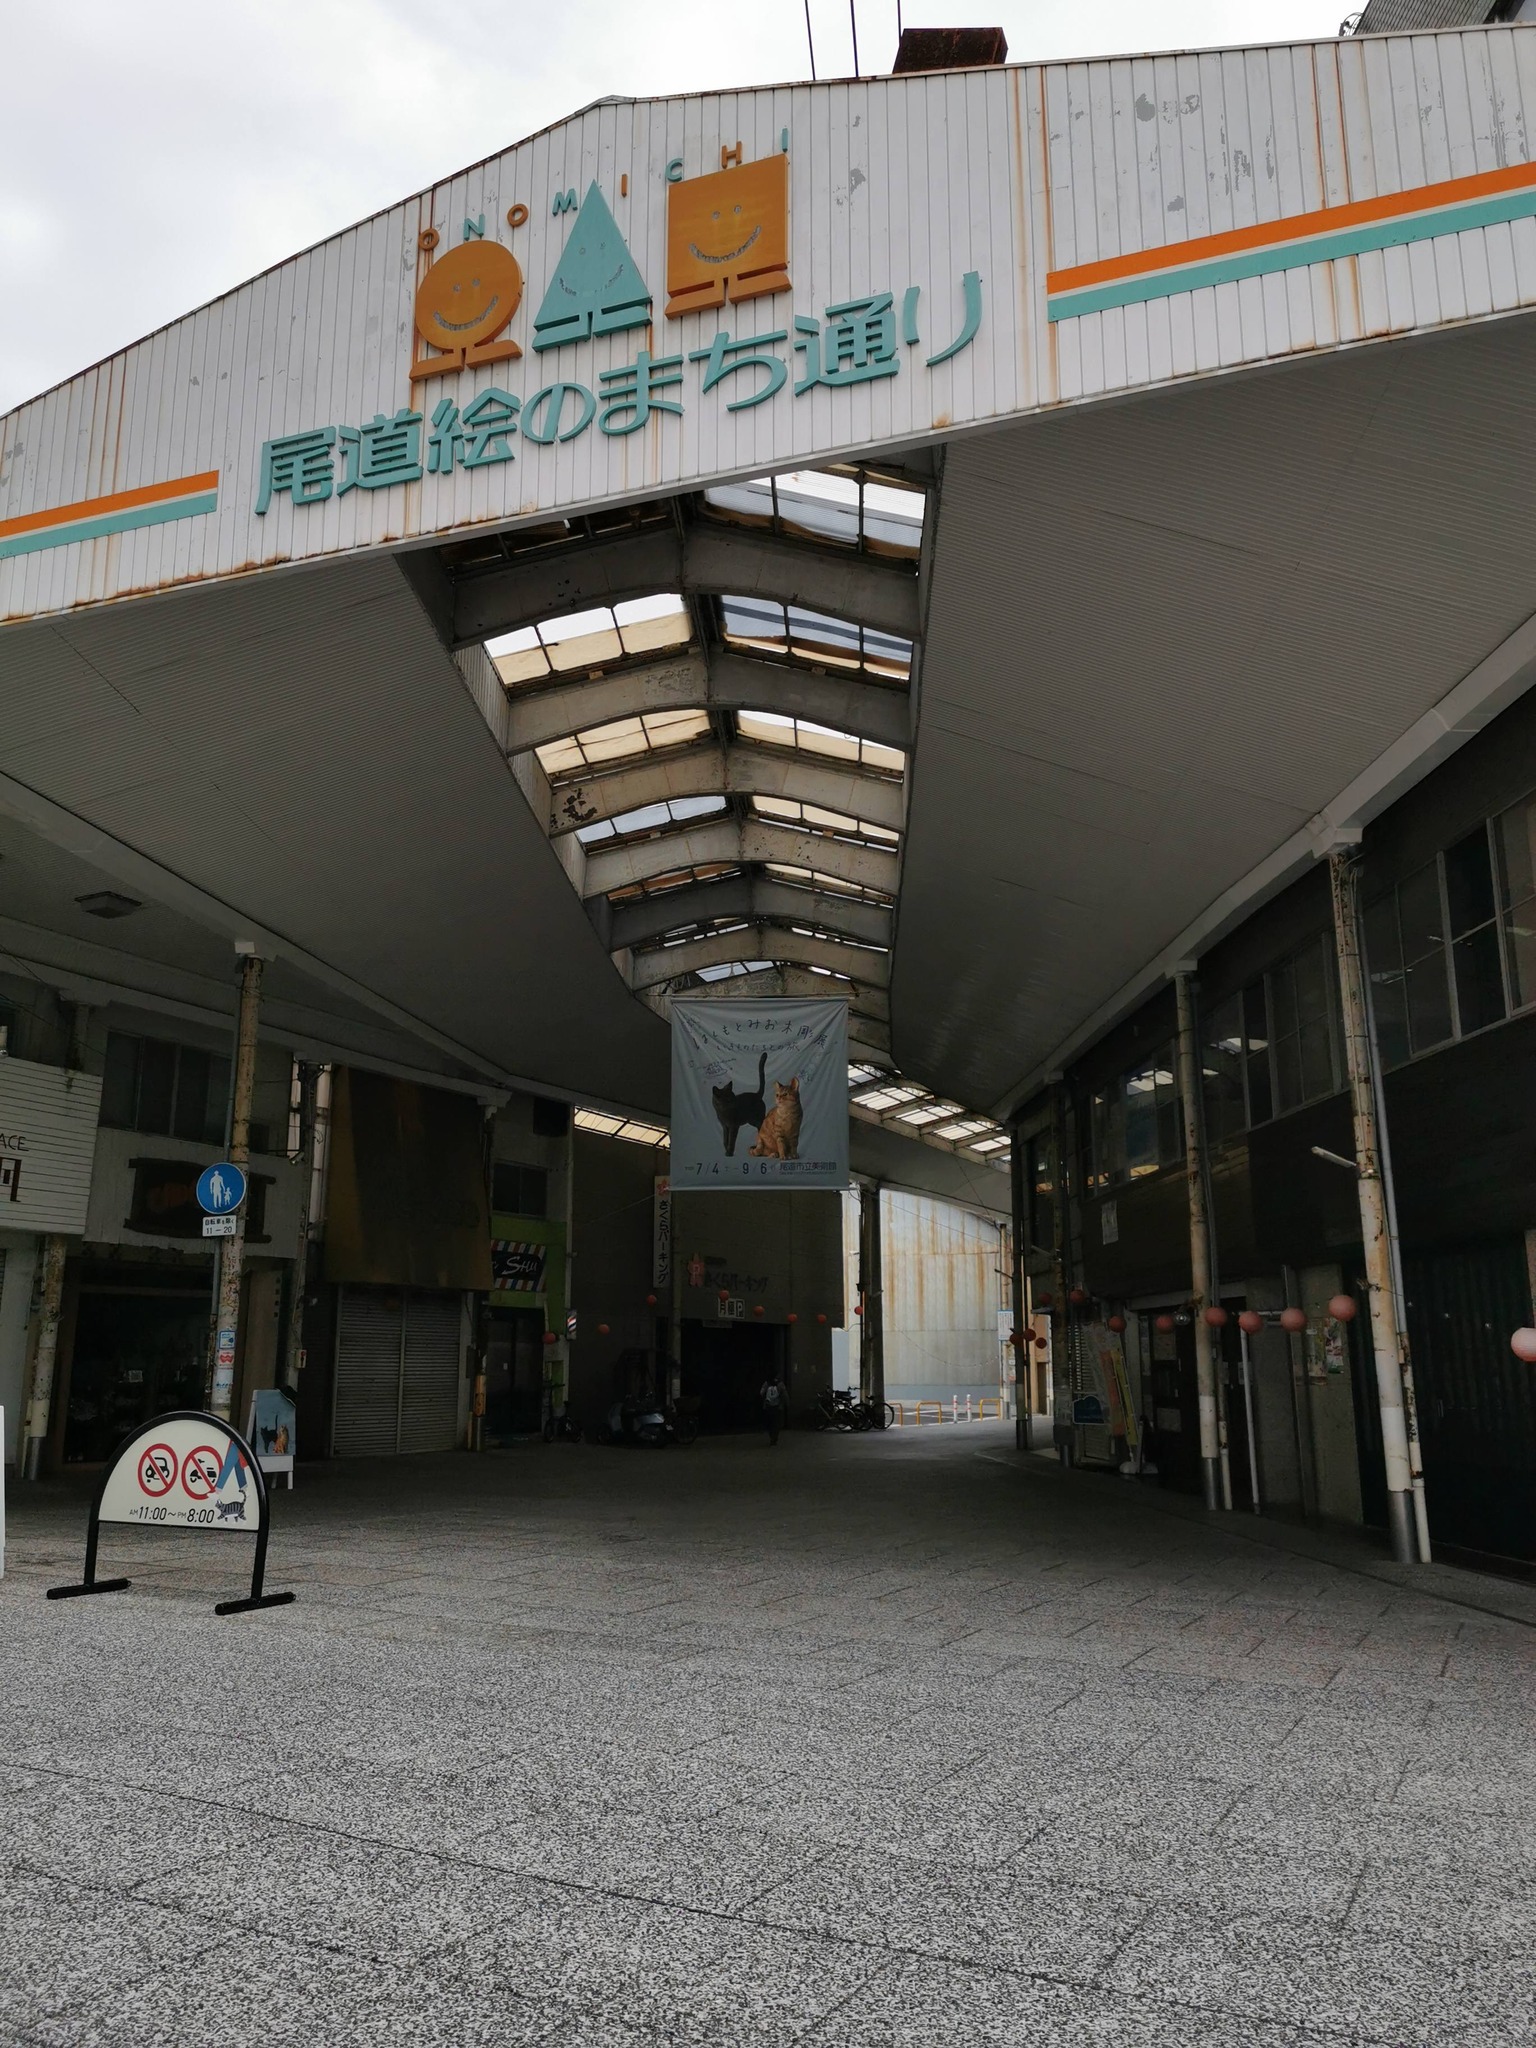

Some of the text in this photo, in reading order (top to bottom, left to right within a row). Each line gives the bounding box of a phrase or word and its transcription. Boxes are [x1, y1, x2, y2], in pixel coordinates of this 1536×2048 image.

[418, 128, 790, 251] ONOMICHI
[255, 271, 983, 517] 尾道絵のまち通り
[657, 1199, 670, 1284] さくらパーキング
